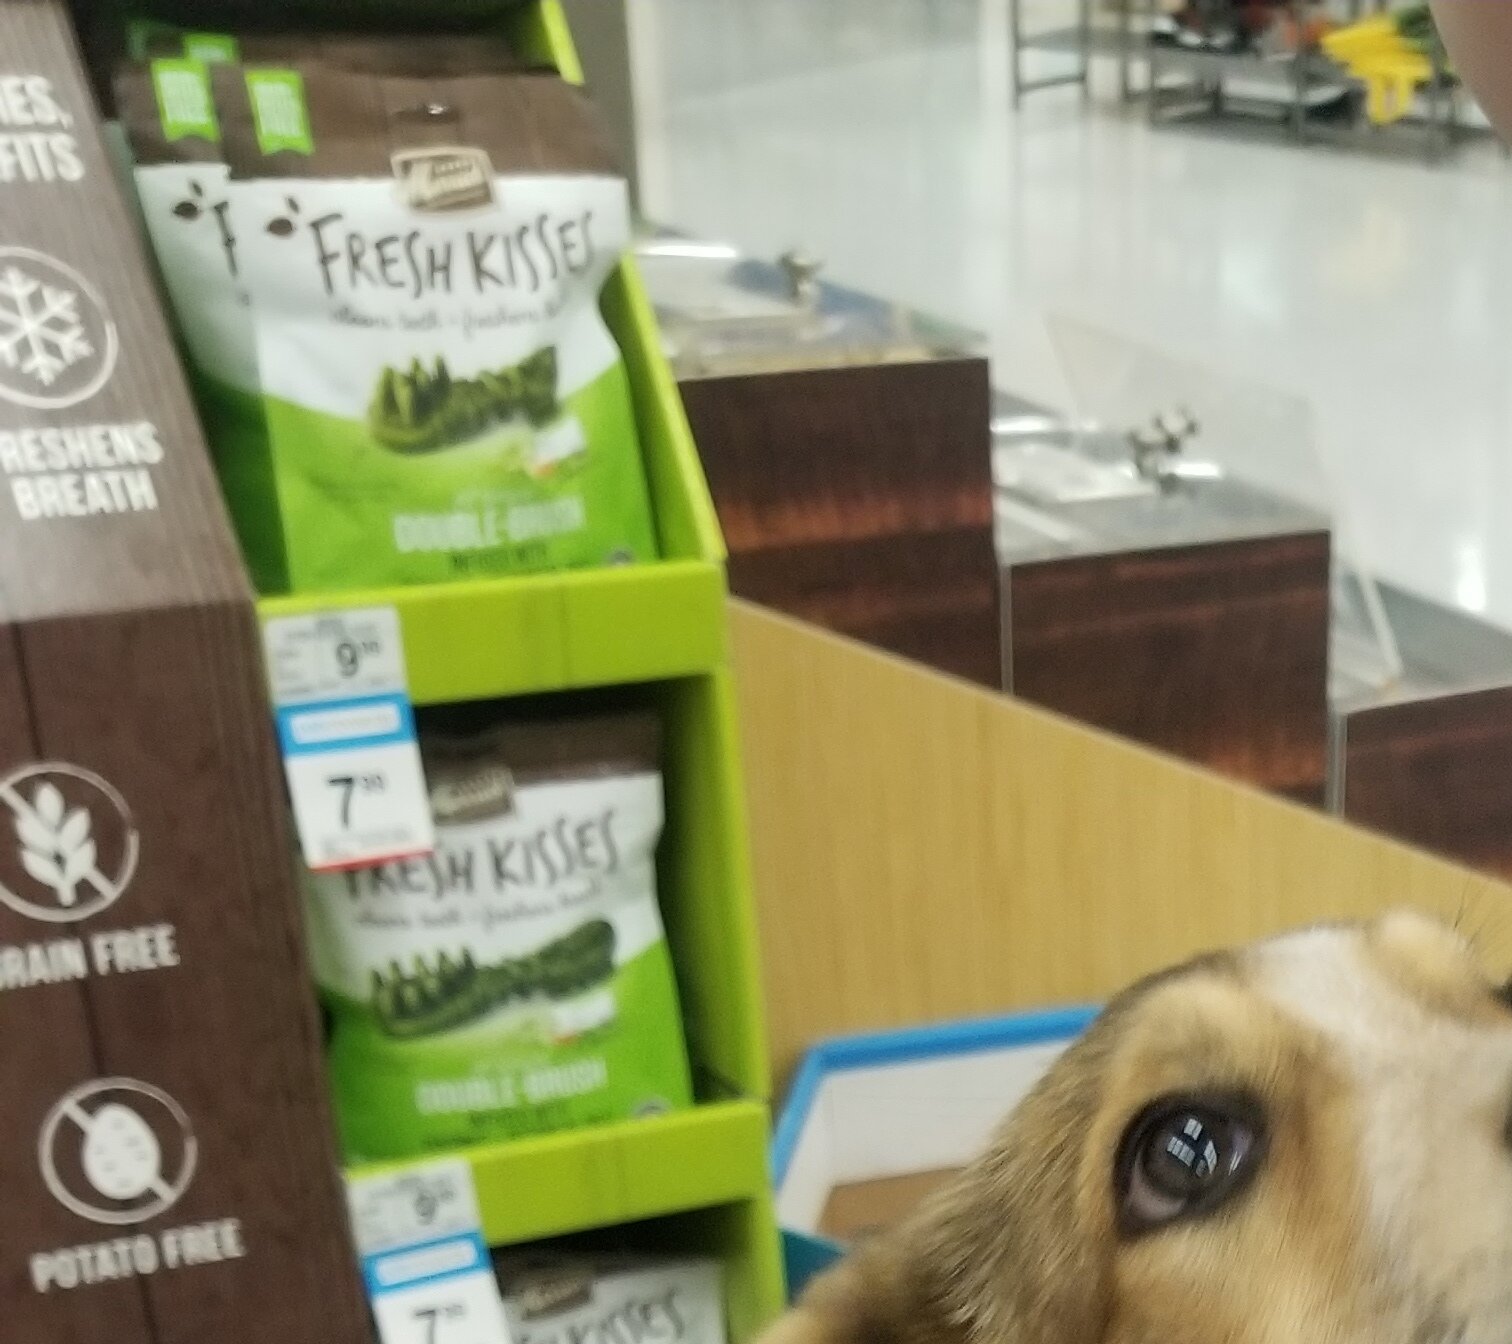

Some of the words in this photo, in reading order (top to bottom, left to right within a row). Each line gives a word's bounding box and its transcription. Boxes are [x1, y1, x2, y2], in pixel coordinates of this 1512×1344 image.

[309, 213, 453, 299] FRESH
[465, 210, 594, 292] KISSES
[10, 467, 160, 521] BREATH
[487, 810, 618, 889] KISSES
[90, 922, 181, 975] FREE
[29, 1233, 159, 1293] POTATO
[160, 1217, 246, 1270] FREE
